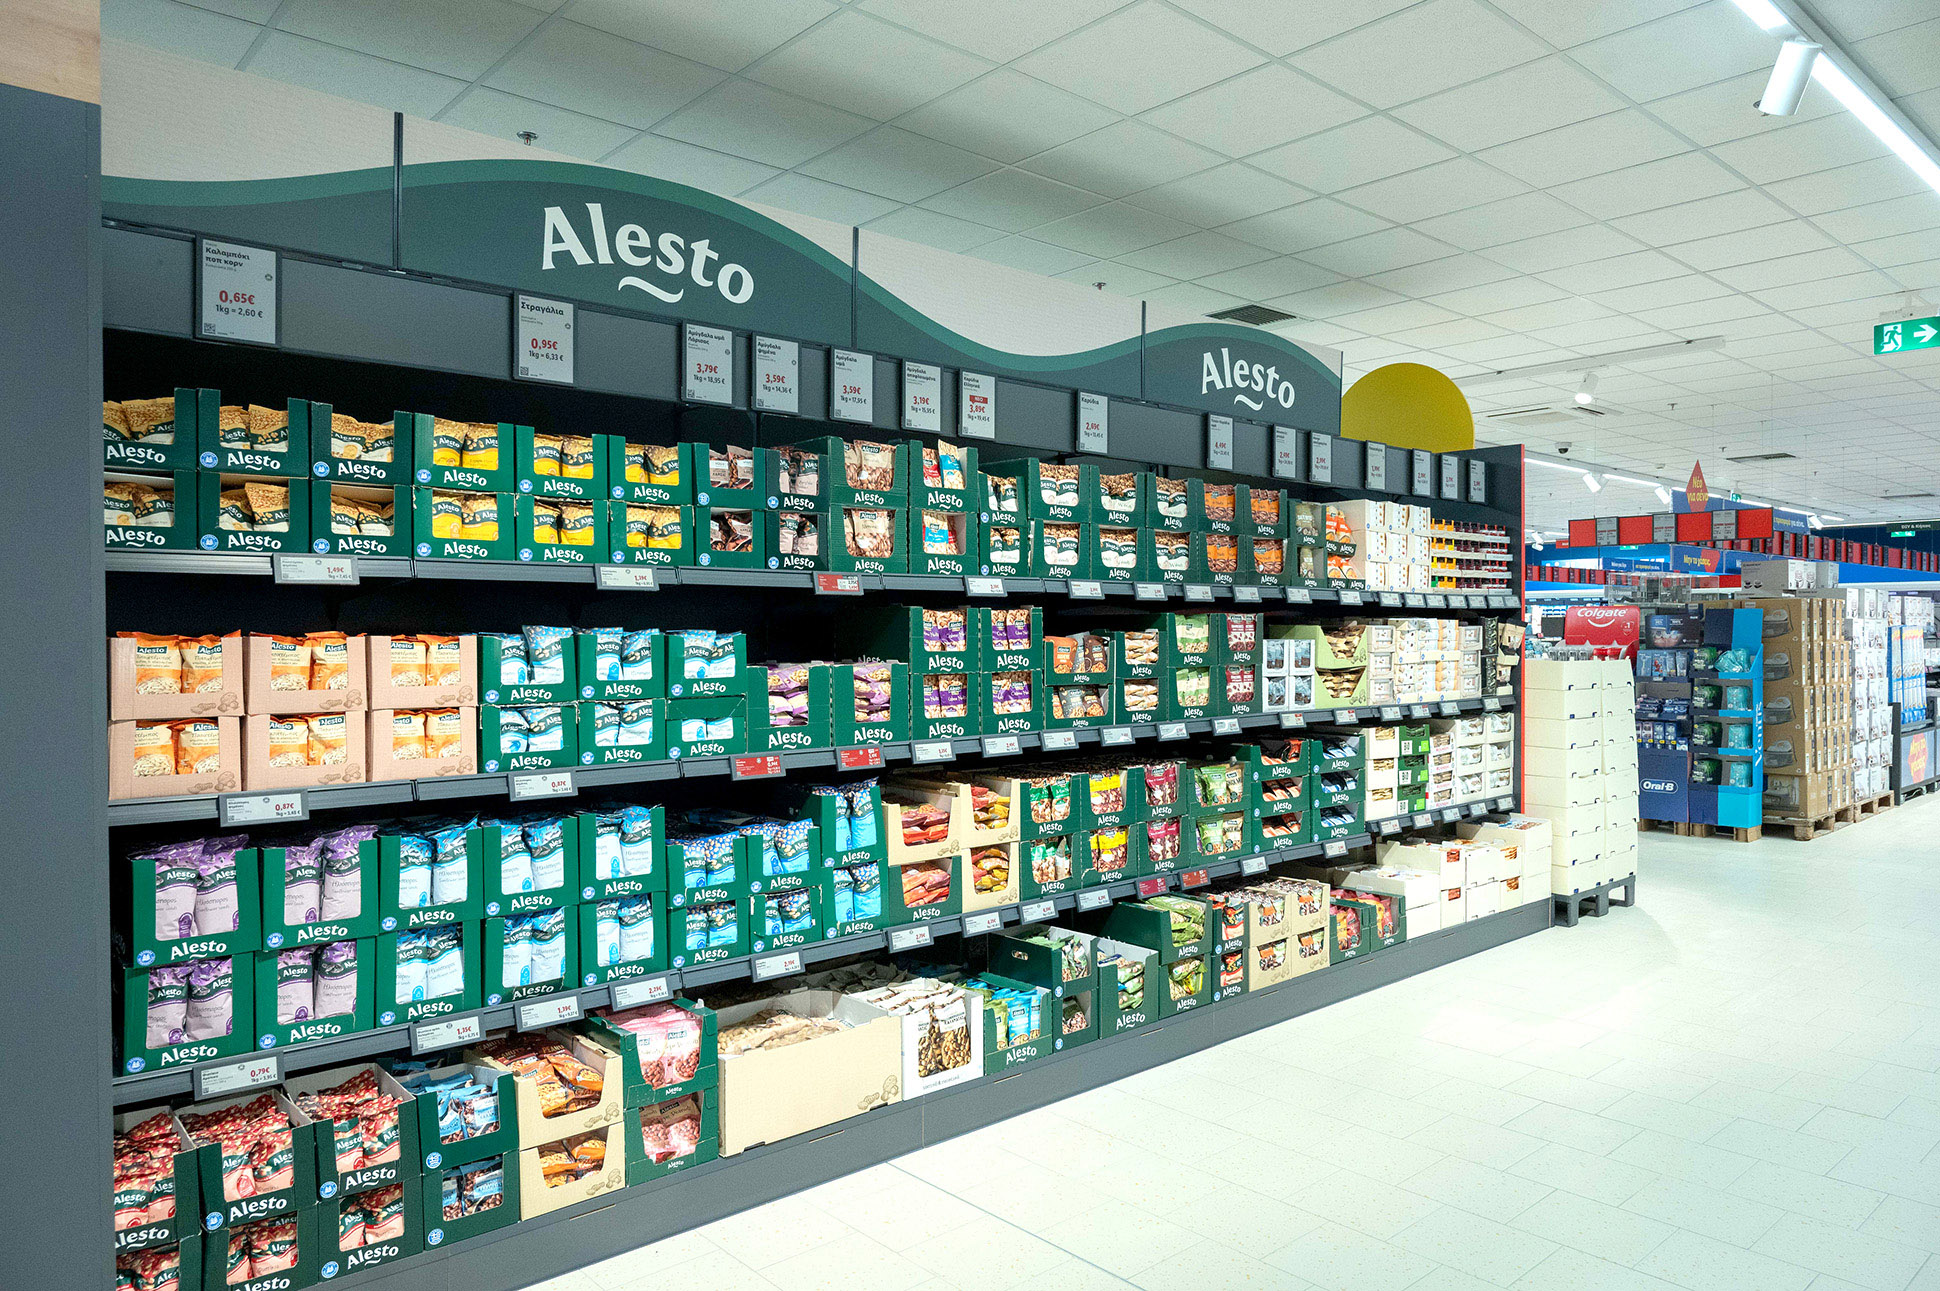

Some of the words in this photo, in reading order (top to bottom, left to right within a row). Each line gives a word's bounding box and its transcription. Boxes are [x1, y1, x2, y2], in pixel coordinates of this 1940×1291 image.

[205, 247, 251, 260] Καλαμπόκι
[542, 203, 754, 304] Alesto
[205, 256, 222, 264] ποπ
[224, 259, 243, 267] κορν
[219, 290, 255, 305] 0,65€
[216, 304, 229, 315] 1kg
[521, 301, 564, 316] Στραγάλια
[531, 338, 558, 350] 0,95€
[696, 363, 719, 374] 3,79€
[765, 373, 786, 384] 3,59€
[1202, 348, 1295, 408] Alesto
[842, 385, 861, 395] 3,59€
[107, 444, 165, 464] Alesto
[228, 451, 280, 470] Alesto
[338, 461, 386, 479] Alesto
[444, 470, 487, 487] Alesto
[544, 479, 583, 496] Alesto
[634, 486, 670, 501] Alesto
[784, 496, 814, 510] Alesto
[855, 491, 884, 506] Alesto
[928, 491, 963, 509] Alesto
[992, 512, 1015, 524] Alesto
[1050, 506, 1072, 518] Alesto
[107, 528, 165, 547] Alesto
[228, 533, 281, 551] Alesto
[339, 537, 386, 554] Alesto
[444, 542, 487, 559] Alesto
[544, 547, 583, 561] Alesto
[635, 549, 671, 564] Alesto
[784, 555, 814, 569] Alesto
[855, 560, 884, 573] Alesto
[928, 557, 962, 572] Alesto
[993, 564, 1016, 576] Alesto
[1049, 566, 1071, 577] Alesto
[1109, 568, 1130, 580] Alesto
[1577, 608, 1627, 619] Colgate
[929, 655, 963, 672] Alesto
[998, 654, 1029, 669] Alesto
[511, 687, 552, 702] Alesto
[605, 683, 642, 697] Alesto
[692, 681, 726, 694] Alesto
[929, 722, 964, 738] Alesto
[998, 718, 1030, 733] Alesto
[769, 731, 811, 749] Alesto
[855, 727, 893, 744] Alesto
[605, 748, 642, 762] Alesto
[690, 741, 724, 756] Alesto
[510, 756, 551, 770] Alesto
[1642, 781, 1675, 791] Oral-B
[275, 803, 294, 811] 0,87€
[1098, 815, 1119, 826] Alesto
[1039, 823, 1062, 834] Alesto
[842, 851, 870, 864] Alesto
[167, 870, 196, 879] Alesto
[1101, 871, 1122, 882] Alesto
[605, 881, 642, 895] Alesto
[770, 876, 802, 889] Alesto
[1041, 881, 1065, 893] Alesto
[512, 895, 552, 911] Alesto
[694, 889, 727, 902] Alesto
[409, 910, 454, 926] Alesto
[913, 908, 940, 920] Alesto
[298, 925, 348, 942] Alesto
[845, 919, 873, 934] Alesto
[773, 934, 804, 948] Alesto
[171, 941, 226, 960] Alesto
[694, 949, 728, 963] Alesto
[283, 966, 307, 978] Alesto
[607, 965, 644, 981] Alesto
[158, 986, 181, 997] Alesto
[512, 985, 554, 1000] Alesto
[407, 1001, 453, 1020] Alesto
[1117, 1013, 1145, 1030] Alesto
[290, 1023, 341, 1042] Alesto
[162, 1045, 217, 1066] Alesto
[1007, 1046, 1036, 1065] Alesto
[250, 1066, 270, 1078] 0,79€
[337, 1136, 362, 1150] Alesto
[346, 1168, 396, 1190] Alesto
[230, 1197, 287, 1222] Alesto
[348, 1245, 398, 1269] Alesto
